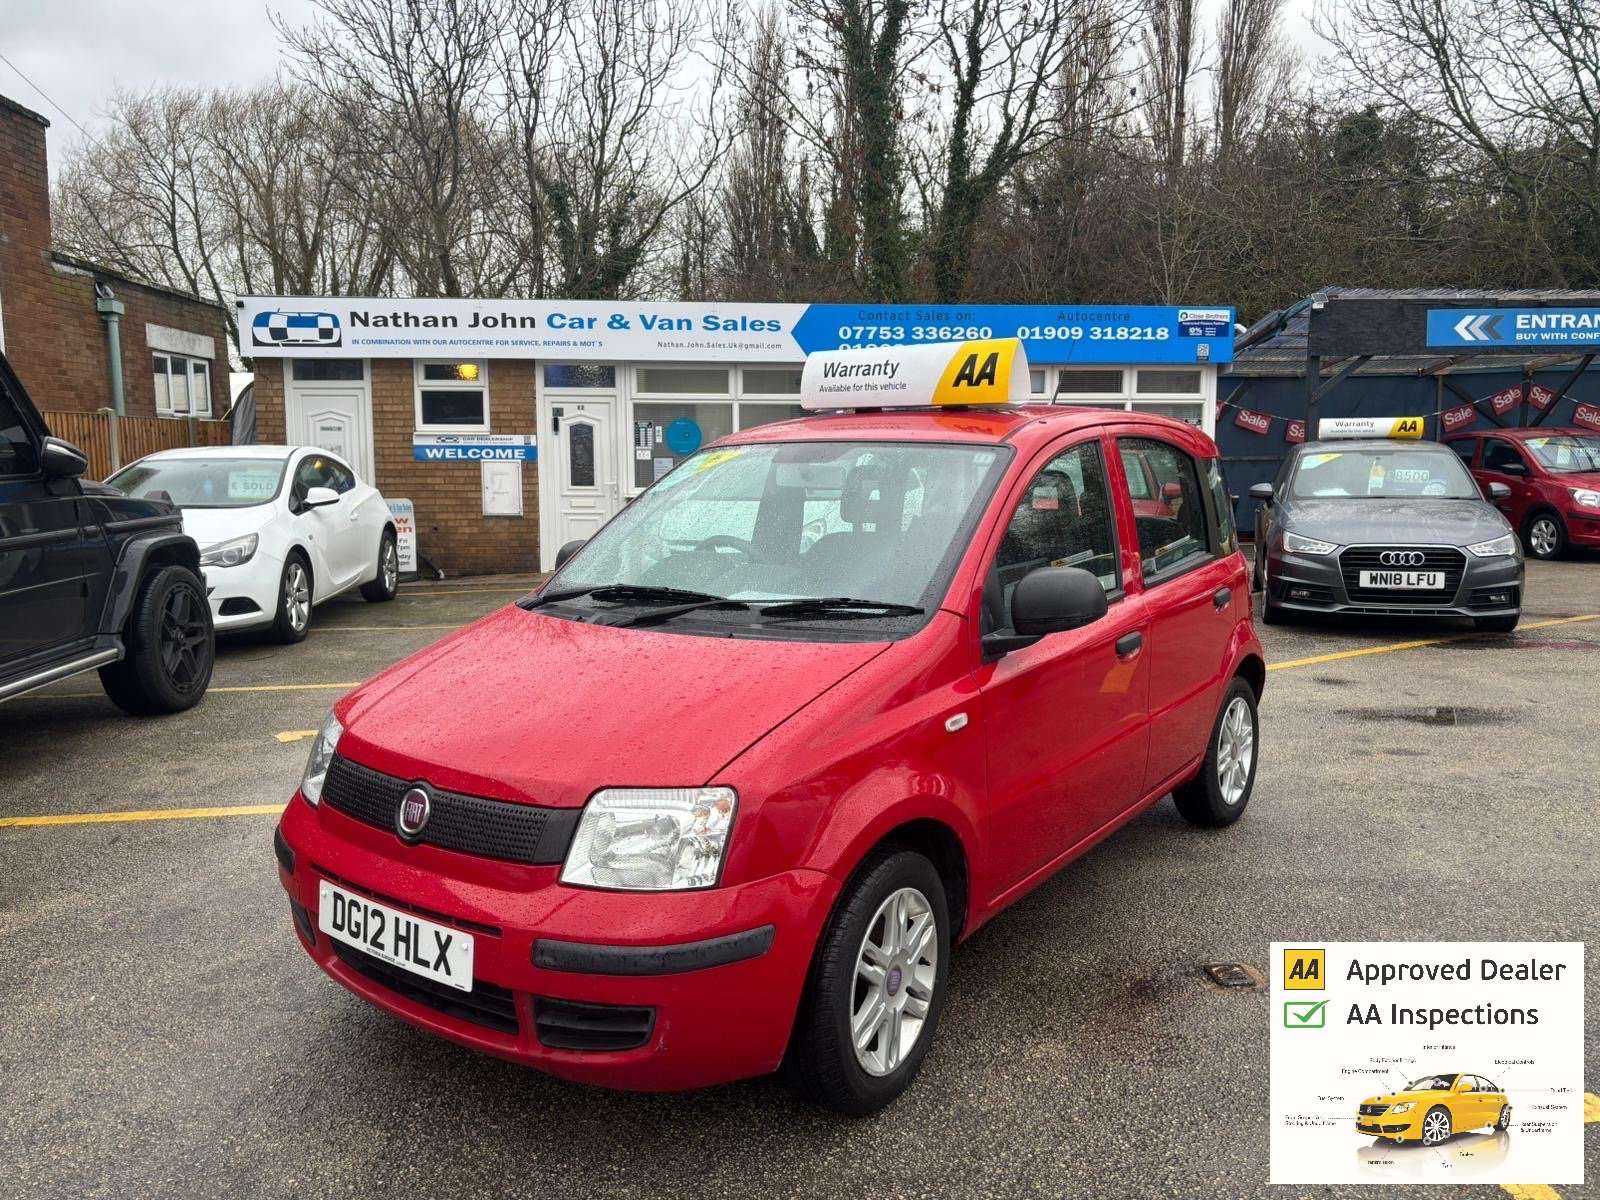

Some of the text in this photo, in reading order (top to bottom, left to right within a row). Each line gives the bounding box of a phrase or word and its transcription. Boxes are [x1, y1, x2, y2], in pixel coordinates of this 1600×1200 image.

[349, 311, 782, 332] Nathan John Car & Van Sales
[858, 310, 909, 321] Contact
[915, 310, 950, 321] Sales
[1057, 311, 1131, 321] Autocentre
[838, 326, 993, 340] 07753 336260
[1017, 326, 1169, 340] 01909 318218
[823, 359, 900, 379] Warranty
[952, 352, 1000, 387] AA
[818, 381, 907, 393] Available for this vehicle
[1494, 388, 1521, 409] Sale
[1530, 386, 1552, 405] Sal
[1239, 409, 1267, 428] Sale
[1444, 406, 1473, 425] Sale
[1288, 424, 1305, 438] Sa
[1397, 420, 1417, 432] AA
[425, 448, 526, 459] WELCOME
[1369, 573, 1437, 586] WN18 LFU
[405, 800, 424, 824] FIAT
[332, 890, 453, 977] DG12 HLX
